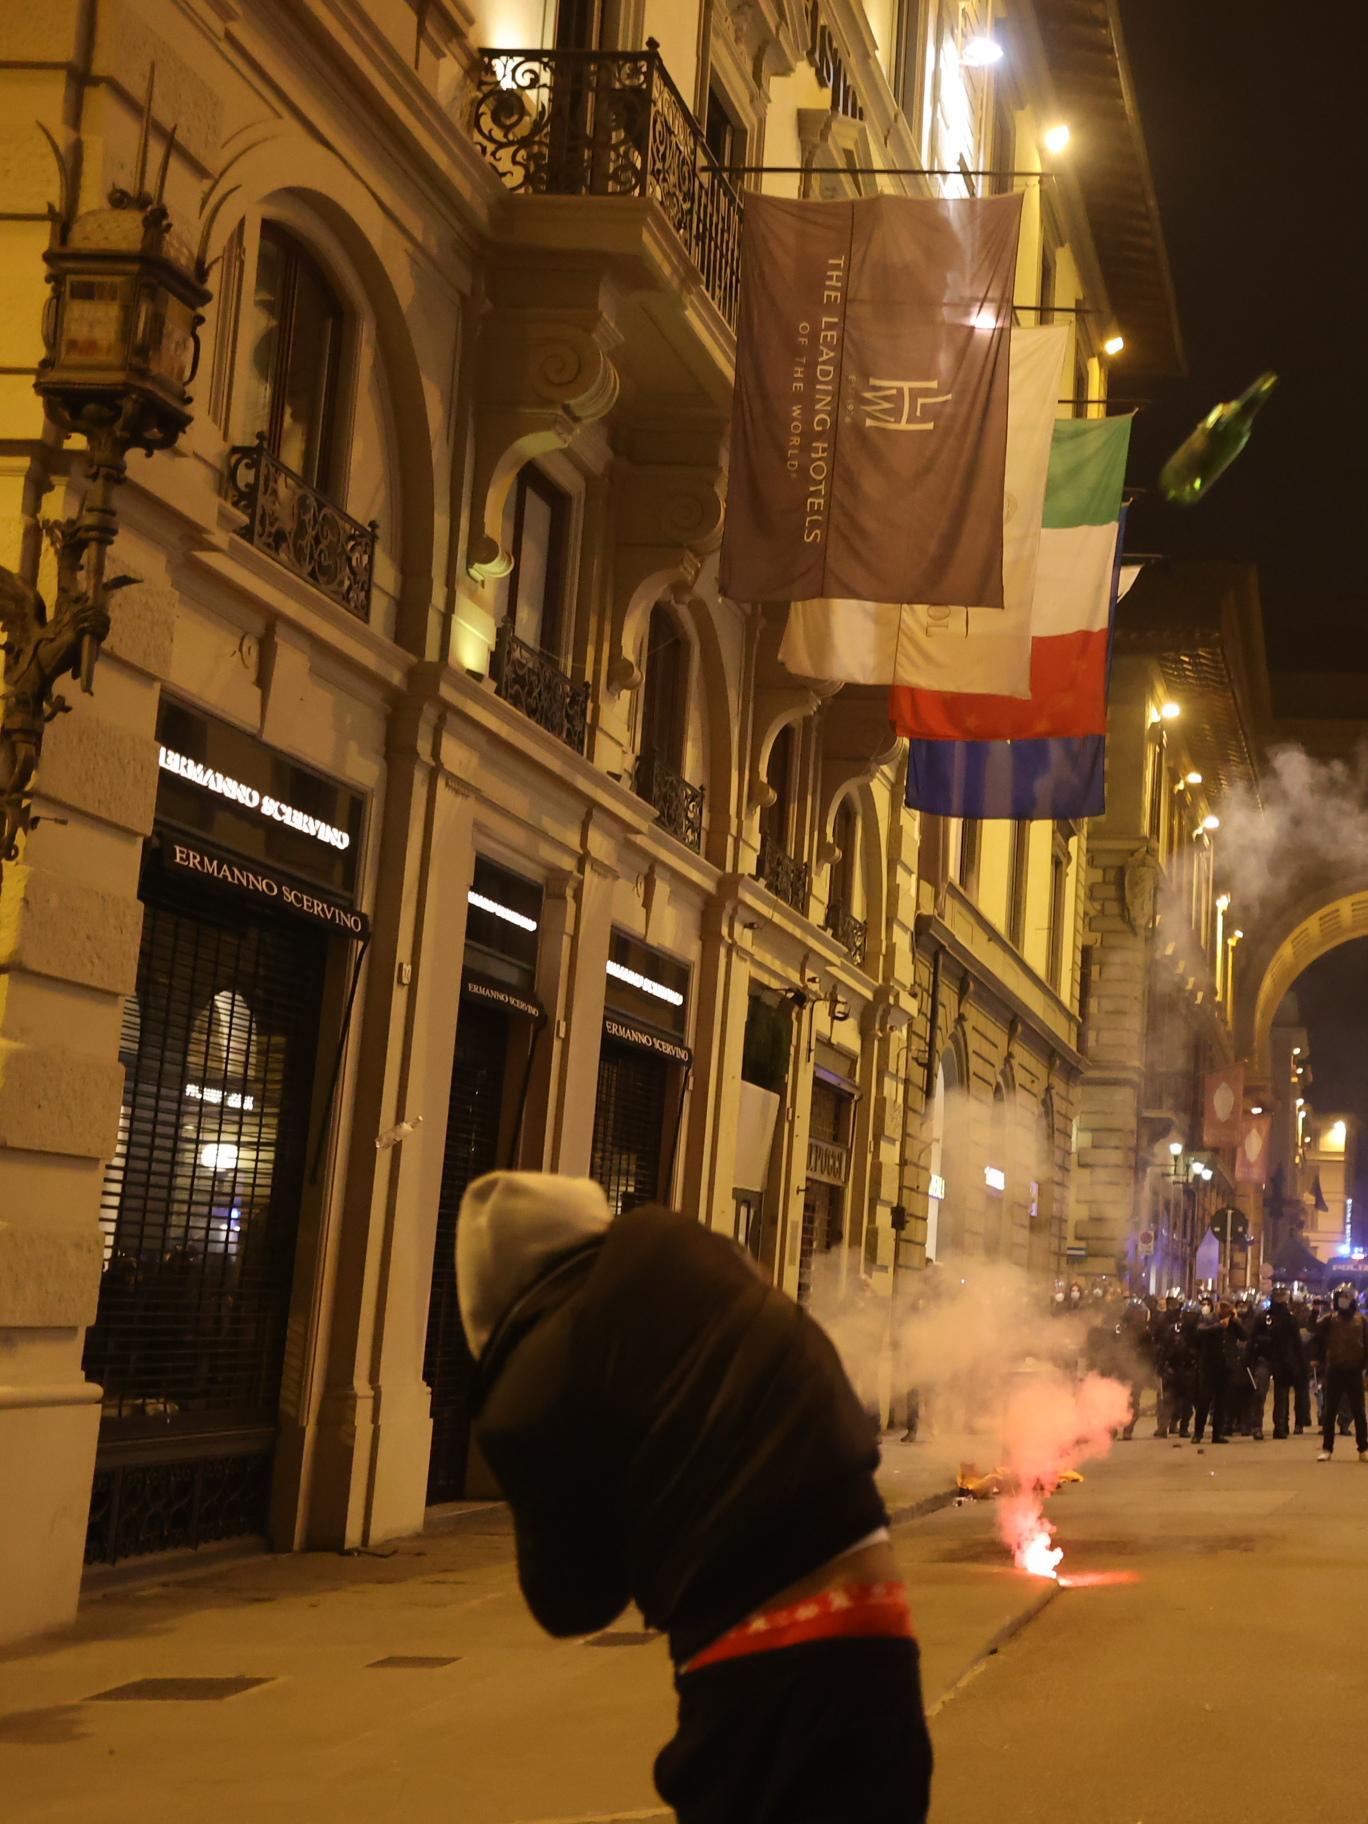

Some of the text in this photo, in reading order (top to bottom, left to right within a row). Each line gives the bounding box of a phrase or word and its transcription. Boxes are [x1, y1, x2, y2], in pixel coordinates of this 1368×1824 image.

[798, 322, 810, 345] OF
[792, 356, 806, 392] THE
[804, 255, 845, 543] THE LEADING HOTELS
[158, 746, 350, 850] ERMANNO SCERVINO
[173, 844, 362, 933] ERMANNO SCERVINO
[467, 982, 540, 1017] ERMANNO SCERVINO
[605, 1020, 689, 1062] ERMANNO SCERVINO
